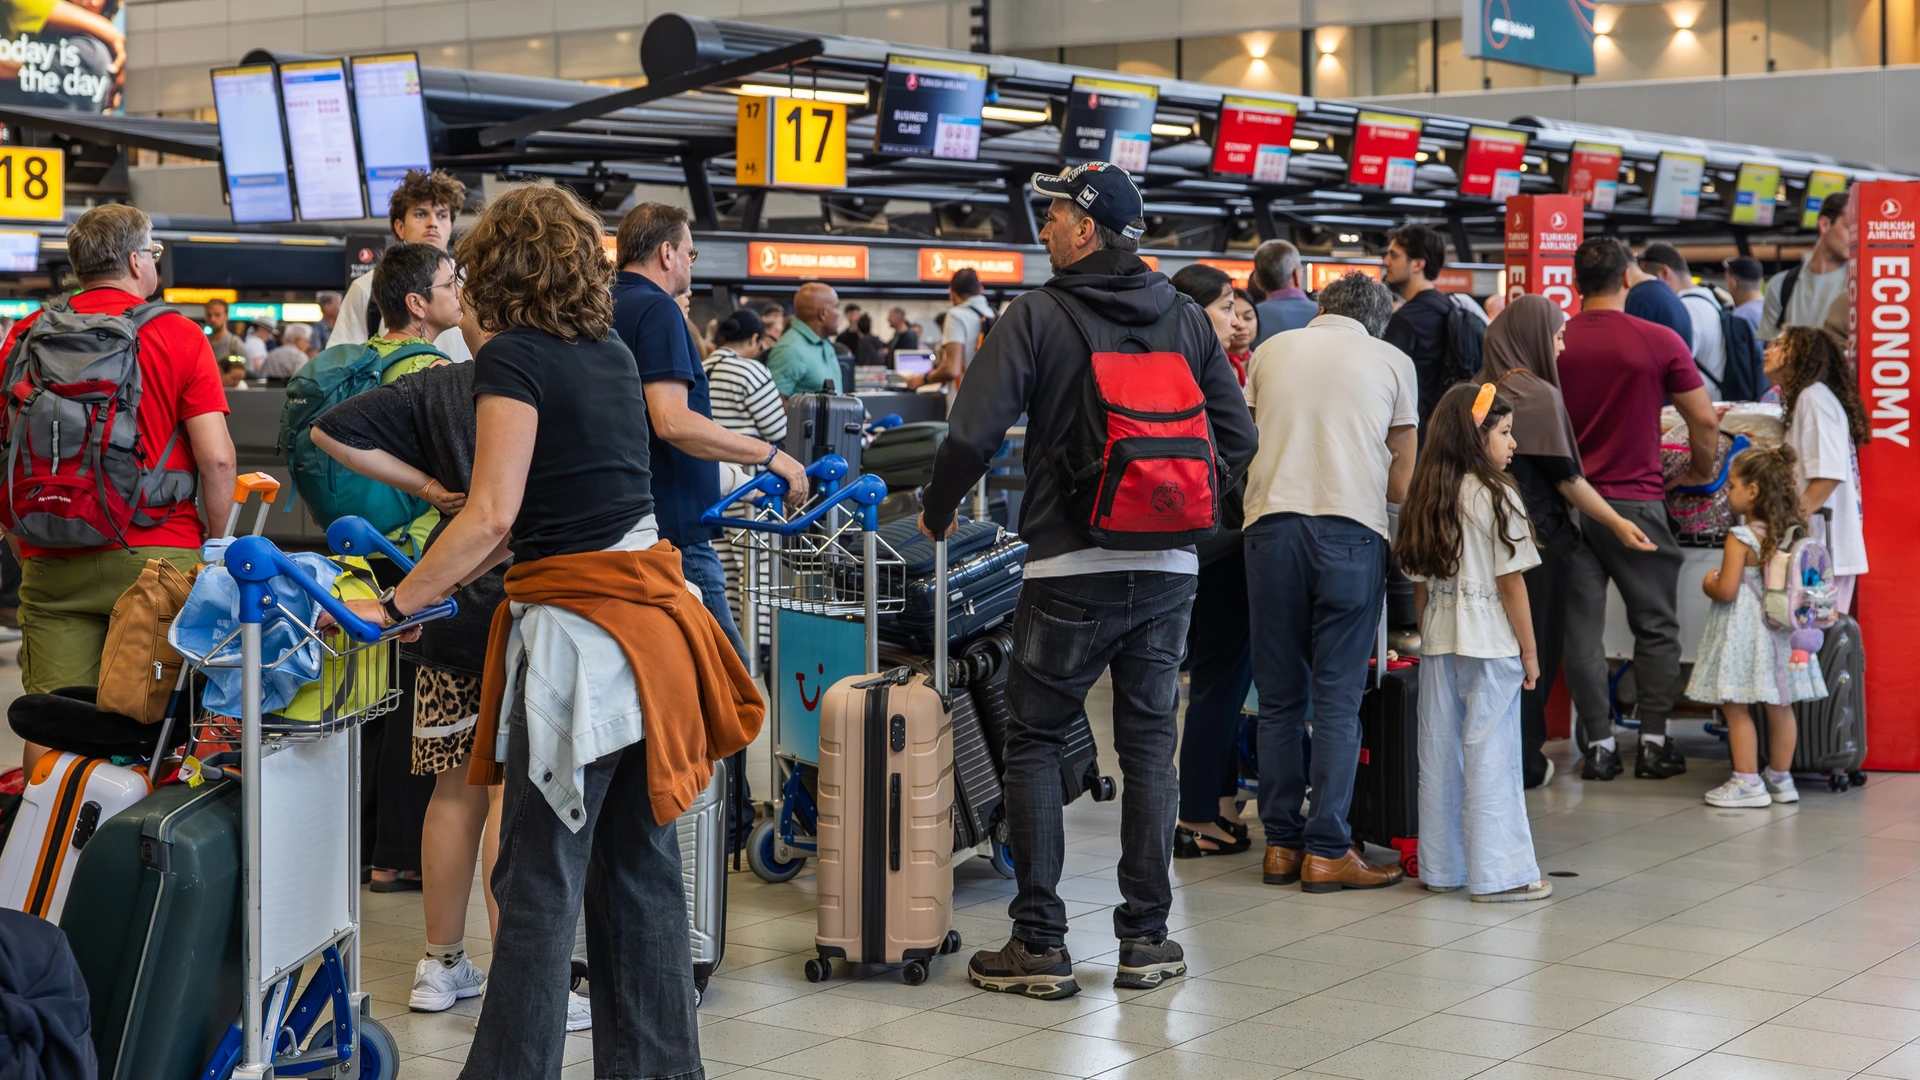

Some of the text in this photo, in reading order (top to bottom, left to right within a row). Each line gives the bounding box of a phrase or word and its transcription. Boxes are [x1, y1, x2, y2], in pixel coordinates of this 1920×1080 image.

[0, 33, 81, 71] oday is
[18, 63, 108, 103] the day
[745, 103, 760, 119] 17
[893, 110, 929, 123] BUSINESS
[786, 106, 834, 163] 17
[898, 122, 921, 135] CLASS
[0, 155, 49, 200] 18
[1866, 220, 1915, 231] TURKISH
[1539, 232, 1577, 241] TURKISH
[1866, 230, 1916, 240] AIRLINES
[1539, 241, 1578, 251] AIRLINES
[779, 253, 857, 269] TURKISH AIRLINES
[981, 260, 1014, 273] AIRLINES
[1871, 256, 1911, 449] ECONOMY
